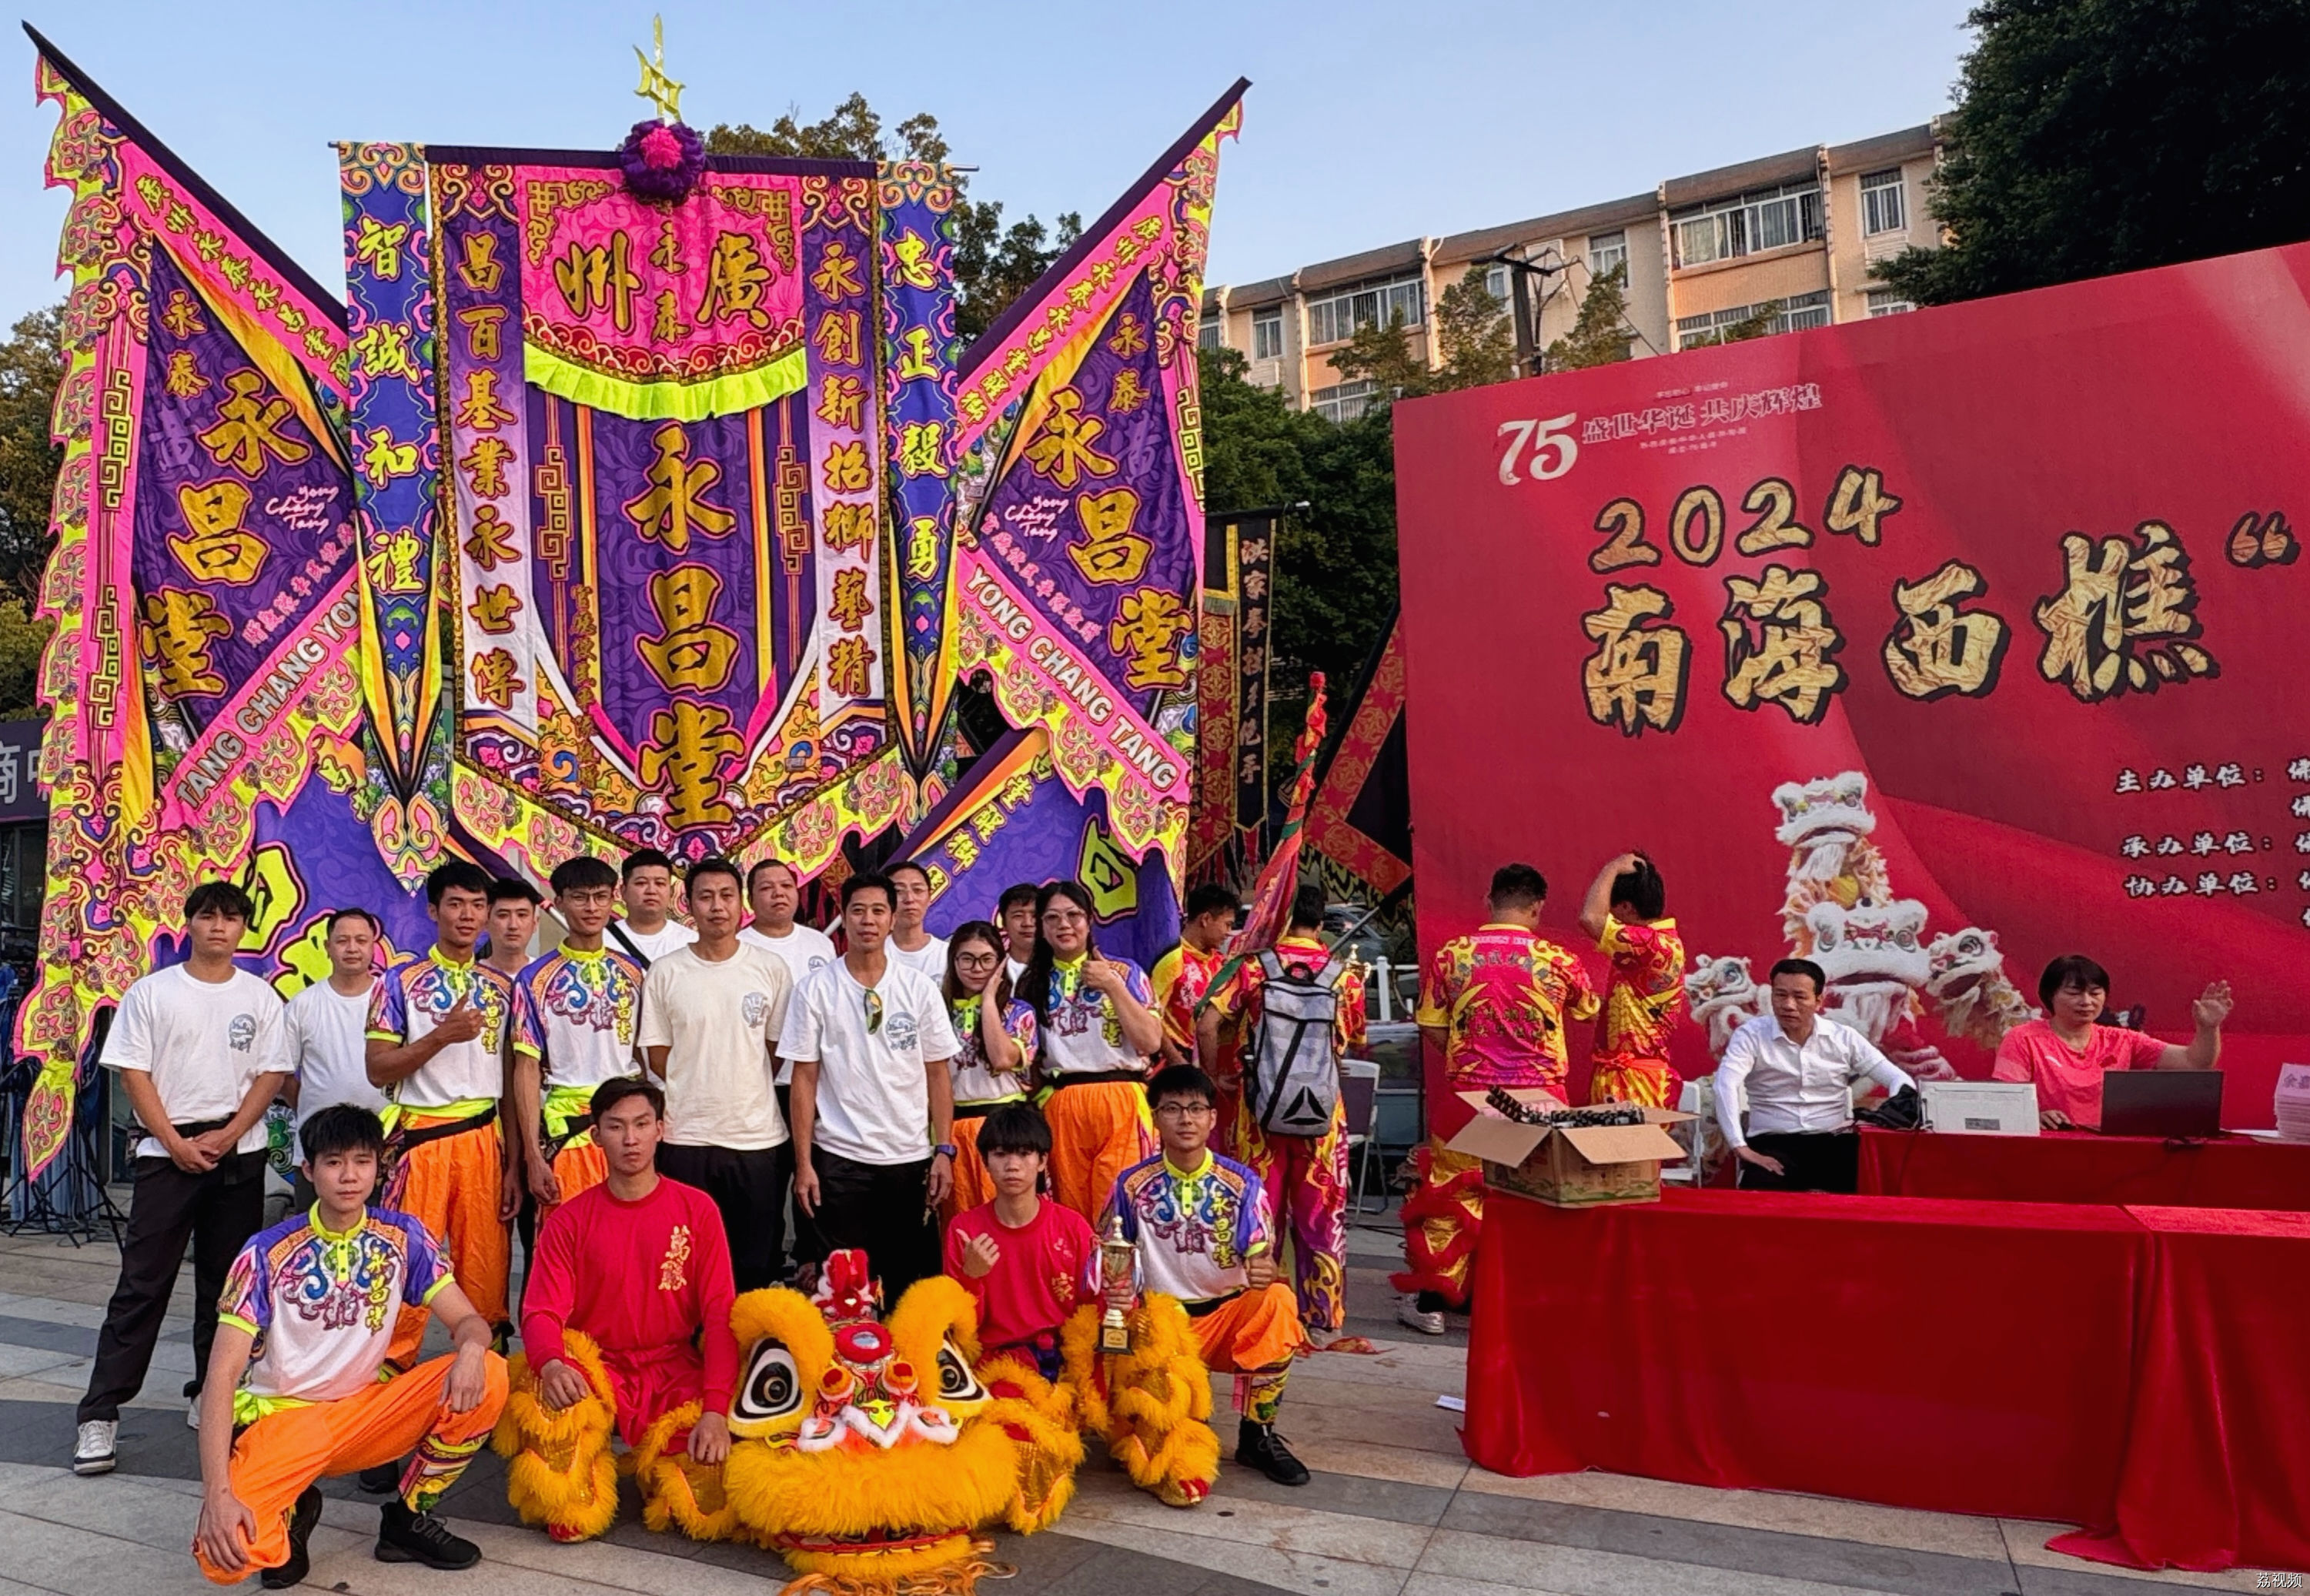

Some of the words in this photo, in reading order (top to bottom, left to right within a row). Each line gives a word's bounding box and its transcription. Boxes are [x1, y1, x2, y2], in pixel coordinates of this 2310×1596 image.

[648, 221, 690, 345] 永泰
[162, 291, 212, 398] 永泰
[1107, 312, 1151, 413] 永泰
[356, 218, 425, 595] 智誠和禮
[892, 232, 948, 582] 忠正毅勇
[1497, 412, 1578, 485] 75
[1582, 403, 1694, 444] 盛世华诞
[1700, 383, 1823, 426] 共庆辉煌
[456, 232, 524, 708] 昌百基業永世傳
[811, 240, 877, 696] 永創新招獅藝精
[1590, 465, 1902, 574] 2024
[141, 369, 309, 700] 永昌堂
[282, 513, 330, 535] Tang
[1018, 522, 1058, 543] Tang
[1024, 387, 1192, 691] 永昌堂
[622, 422, 747, 833] 永昌堂
[965, 563, 1035, 643] YONG
[1028, 633, 1115, 724] CHANG
[1108, 714, 1180, 791] TANG
[175, 733, 246, 812] TANG
[235, 636, 327, 737] CHANG
[2114, 764, 2265, 794] 主办单位：
[2121, 830, 2272, 858] 承办单位：
[2124, 871, 2276, 897] 协办单位：
[480, 983, 502, 1055] 永昌堂
[614, 972, 633, 1046] 永昌堂
[1210, 1190, 1237, 1270] 永昌堂
[366, 1247, 391, 1337] 永昌堂
